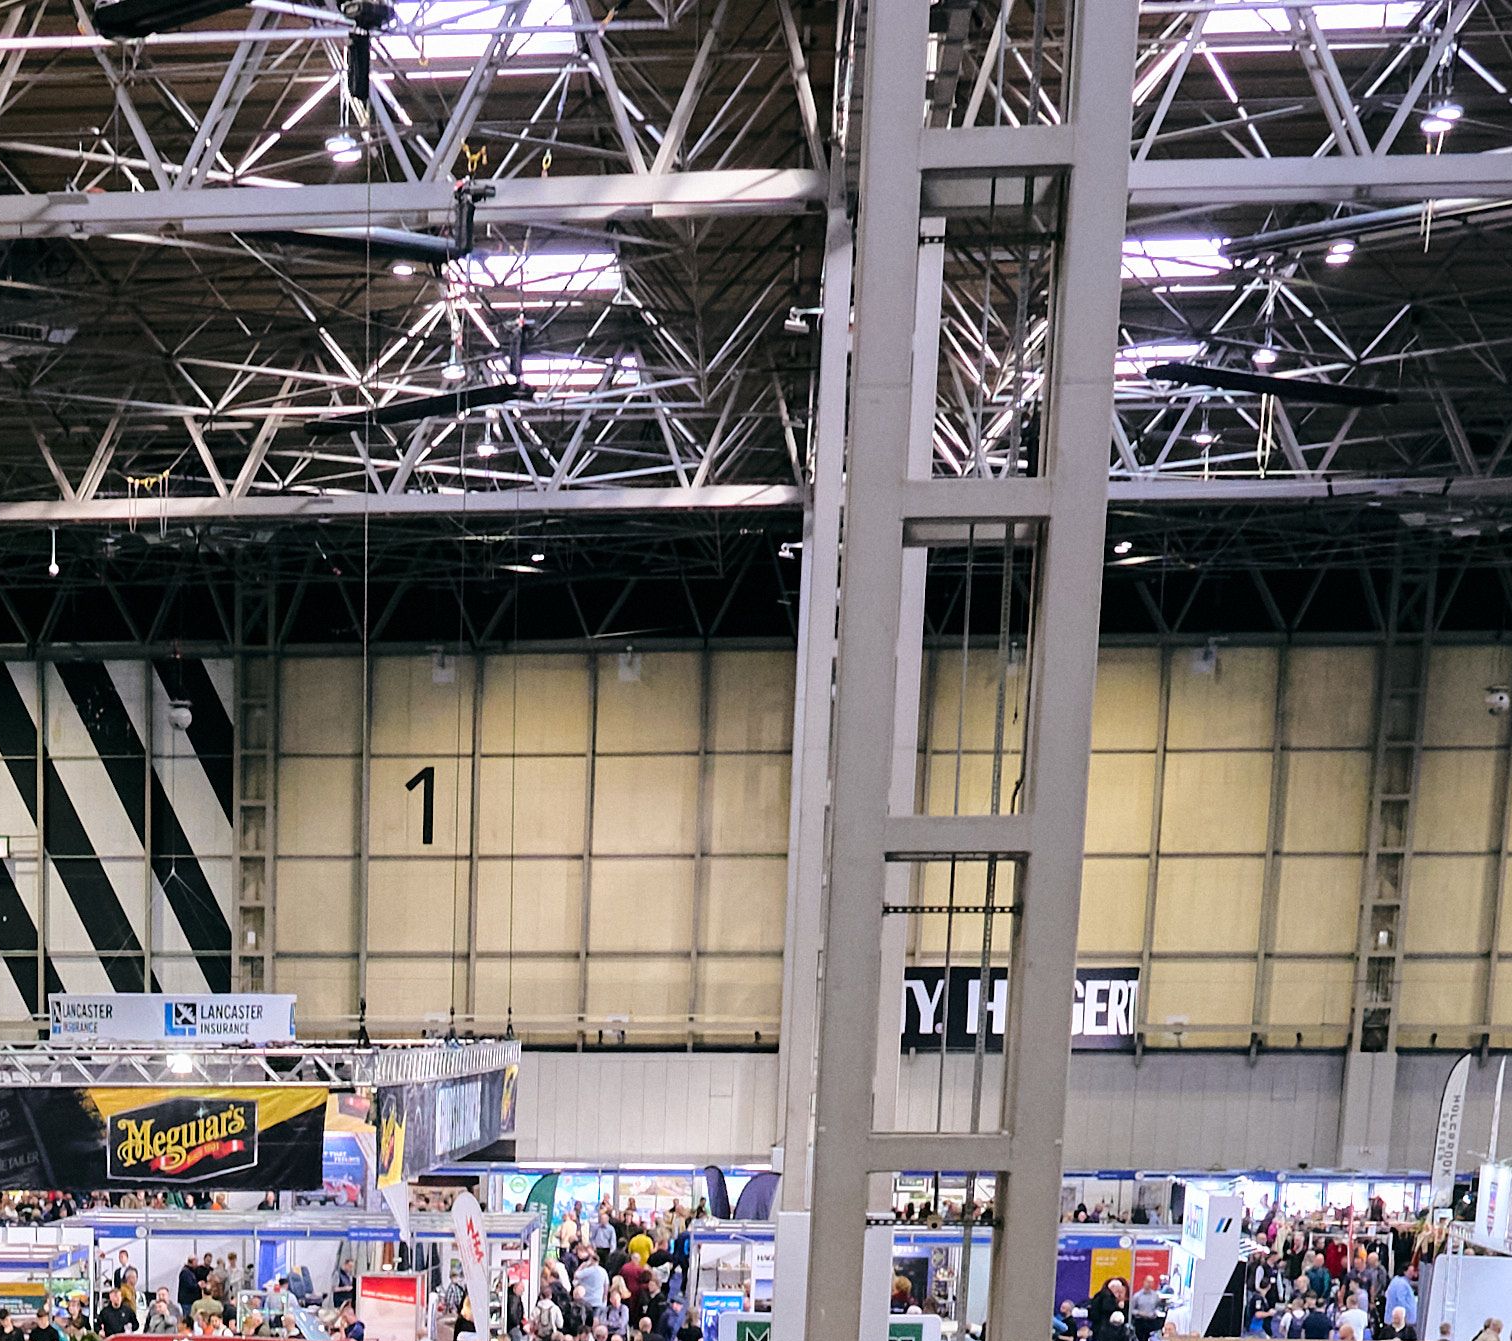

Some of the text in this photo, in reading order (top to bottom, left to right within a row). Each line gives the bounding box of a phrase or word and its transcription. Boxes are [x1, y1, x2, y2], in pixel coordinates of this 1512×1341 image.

[404, 766, 437, 845] 1
[62, 1003, 113, 1020] LANCASTER
[200, 1003, 264, 1020] LANCASTER
[200, 1022, 250, 1035] INSURANCE
[116, 1103, 246, 1171] Meguiar's
